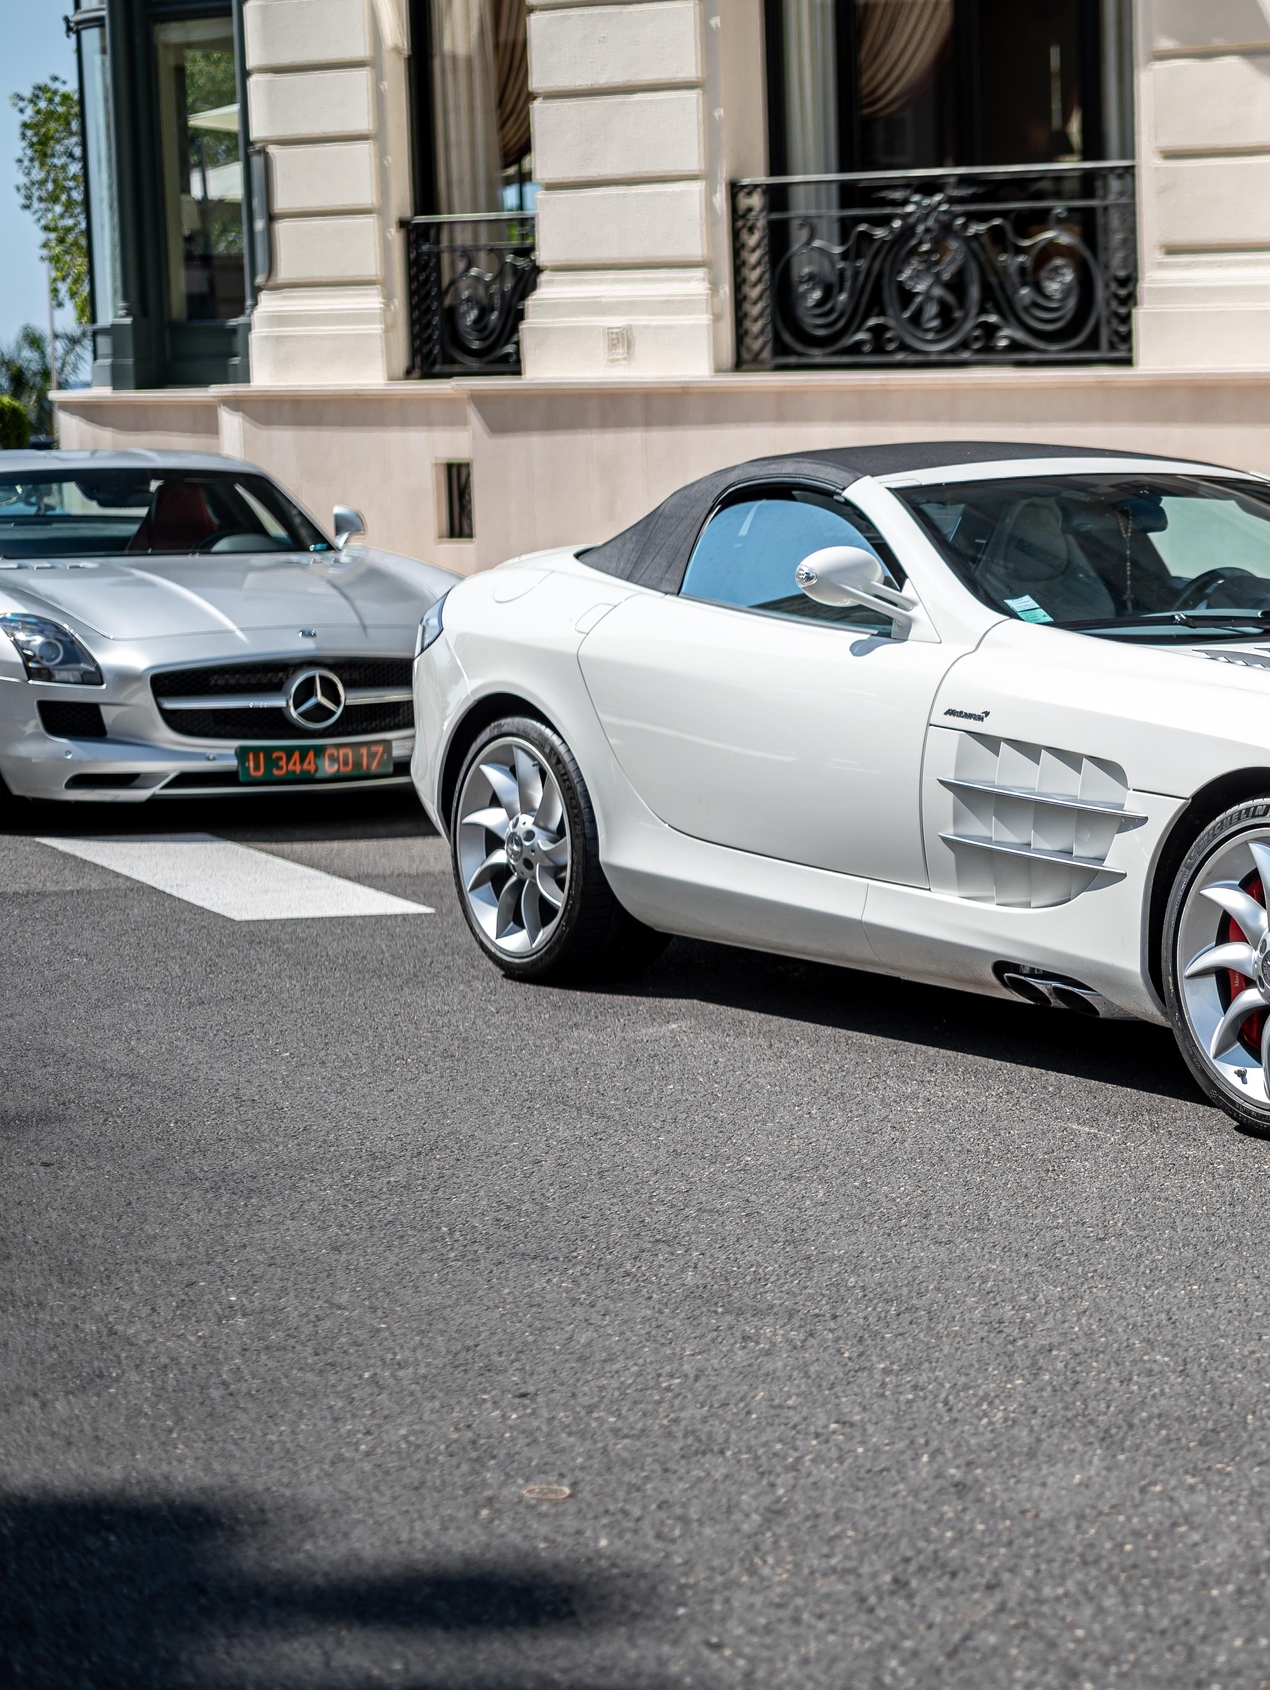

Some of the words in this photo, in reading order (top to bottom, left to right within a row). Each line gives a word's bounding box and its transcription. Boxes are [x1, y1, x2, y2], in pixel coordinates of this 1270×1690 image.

[249, 751, 265, 777] U
[272, 749, 316, 777] 344
[324, 747, 353, 774] CD
[359, 745, 384, 771] 17
[1195, 805, 1267, 850] MICHELIN
